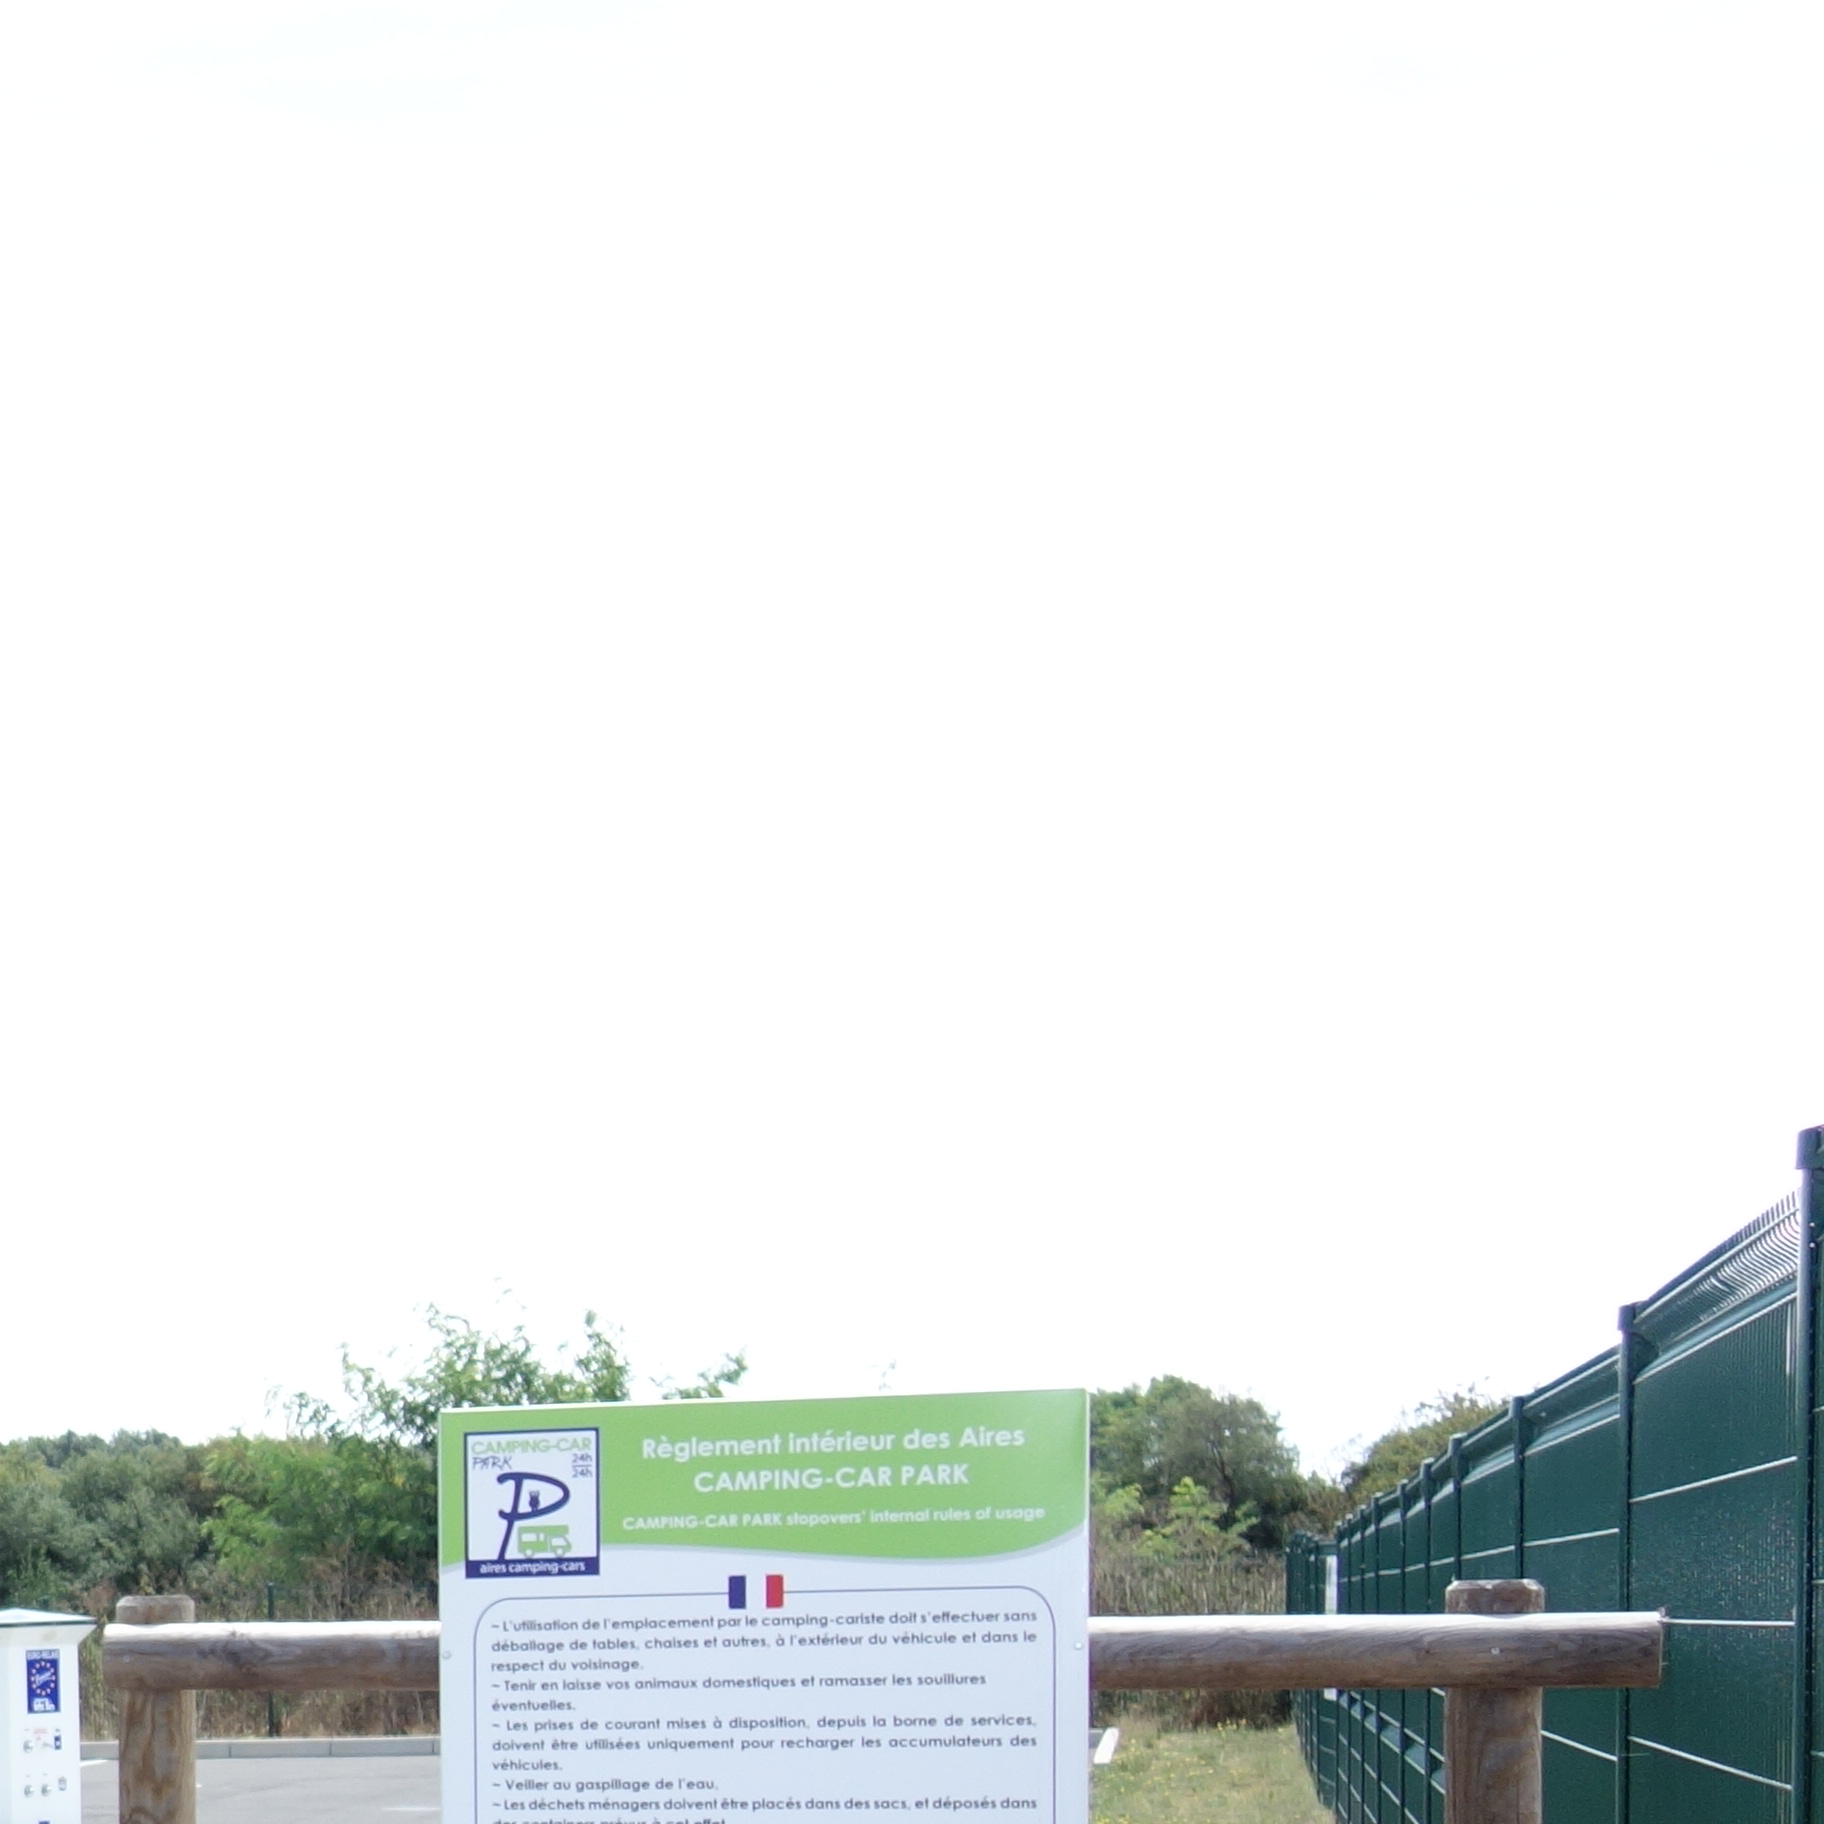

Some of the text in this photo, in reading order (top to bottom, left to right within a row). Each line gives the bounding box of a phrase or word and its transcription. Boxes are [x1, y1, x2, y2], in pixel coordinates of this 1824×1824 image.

[471, 1437, 592, 1455] CAMPING-CAR
[642, 1424, 1024, 1462] Règlement intérieur des Aires
[472, 1455, 512, 1470] PARK
[694, 1463, 968, 1493] CAMPING-CAR PARK
[622, 1506, 1045, 1530] CAMPING-CAR PARK stopovers' internal rules of usage
[480, 1561, 585, 1575] aires camping-cars
[502, 1609, 1037, 1632] L'utilisation de l'emplacement par le camping-cariste doit s'effectuer sans
[491, 1638, 564, 1654] déballage
[569, 1638, 588, 1650] de
[644, 1636, 698, 1649] chaises
[703, 1636, 717, 1648] et
[775, 1633, 785, 1647] à
[790, 1632, 863, 1646] l'extérieur
[868, 1632, 887, 1645] du
[892, 1630, 957, 1645] véhicule
[961, 1631, 976, 1643] et
[981, 1630, 1018, 1643] dans
[1023, 1630, 1037, 1642] le
[490, 1659, 544, 1674] respect
[548, 1658, 566, 1671] du
[504, 1672, 986, 1691] Tenir en laisse vos animaux domestiques et ramasser les souillures
[506, 1719, 528, 1731] Les
[534, 1718, 573, 1733] prises
[579, 1718, 598, 1730] de
[604, 1717, 660, 1730] courant
[666, 1717, 706, 1729] mises
[712, 1715, 722, 1729] à
[816, 1715, 866, 1730] depuis
[872, 1715, 886, 1727] la
[893, 1714, 937, 1727] borne
[943, 1714, 964, 1726] de
[491, 1734, 1037, 1752] doivent être utilisées uniquement pour recharger les accumulateurs des
[505, 1779, 549, 1791] Veiller
[552, 1781, 571, 1790] au
[575, 1778, 650, 1793] gaspillage
[654, 1778, 673, 1790] de
[503, 1799, 525, 1810] Les
[528, 1797, 585, 1810] déchets
[588, 1797, 660, 1812] ménagers
[663, 1798, 717, 1810] doivent
[720, 1797, 749, 1810] être
[751, 1797, 801, 1812] placés
[804, 1797, 840, 1809] dans
[843, 1797, 870, 1809] des
[914, 1797, 929, 1809] et
[932, 1795, 996, 1812] déposés
[999, 1796, 1037, 1809] dans
